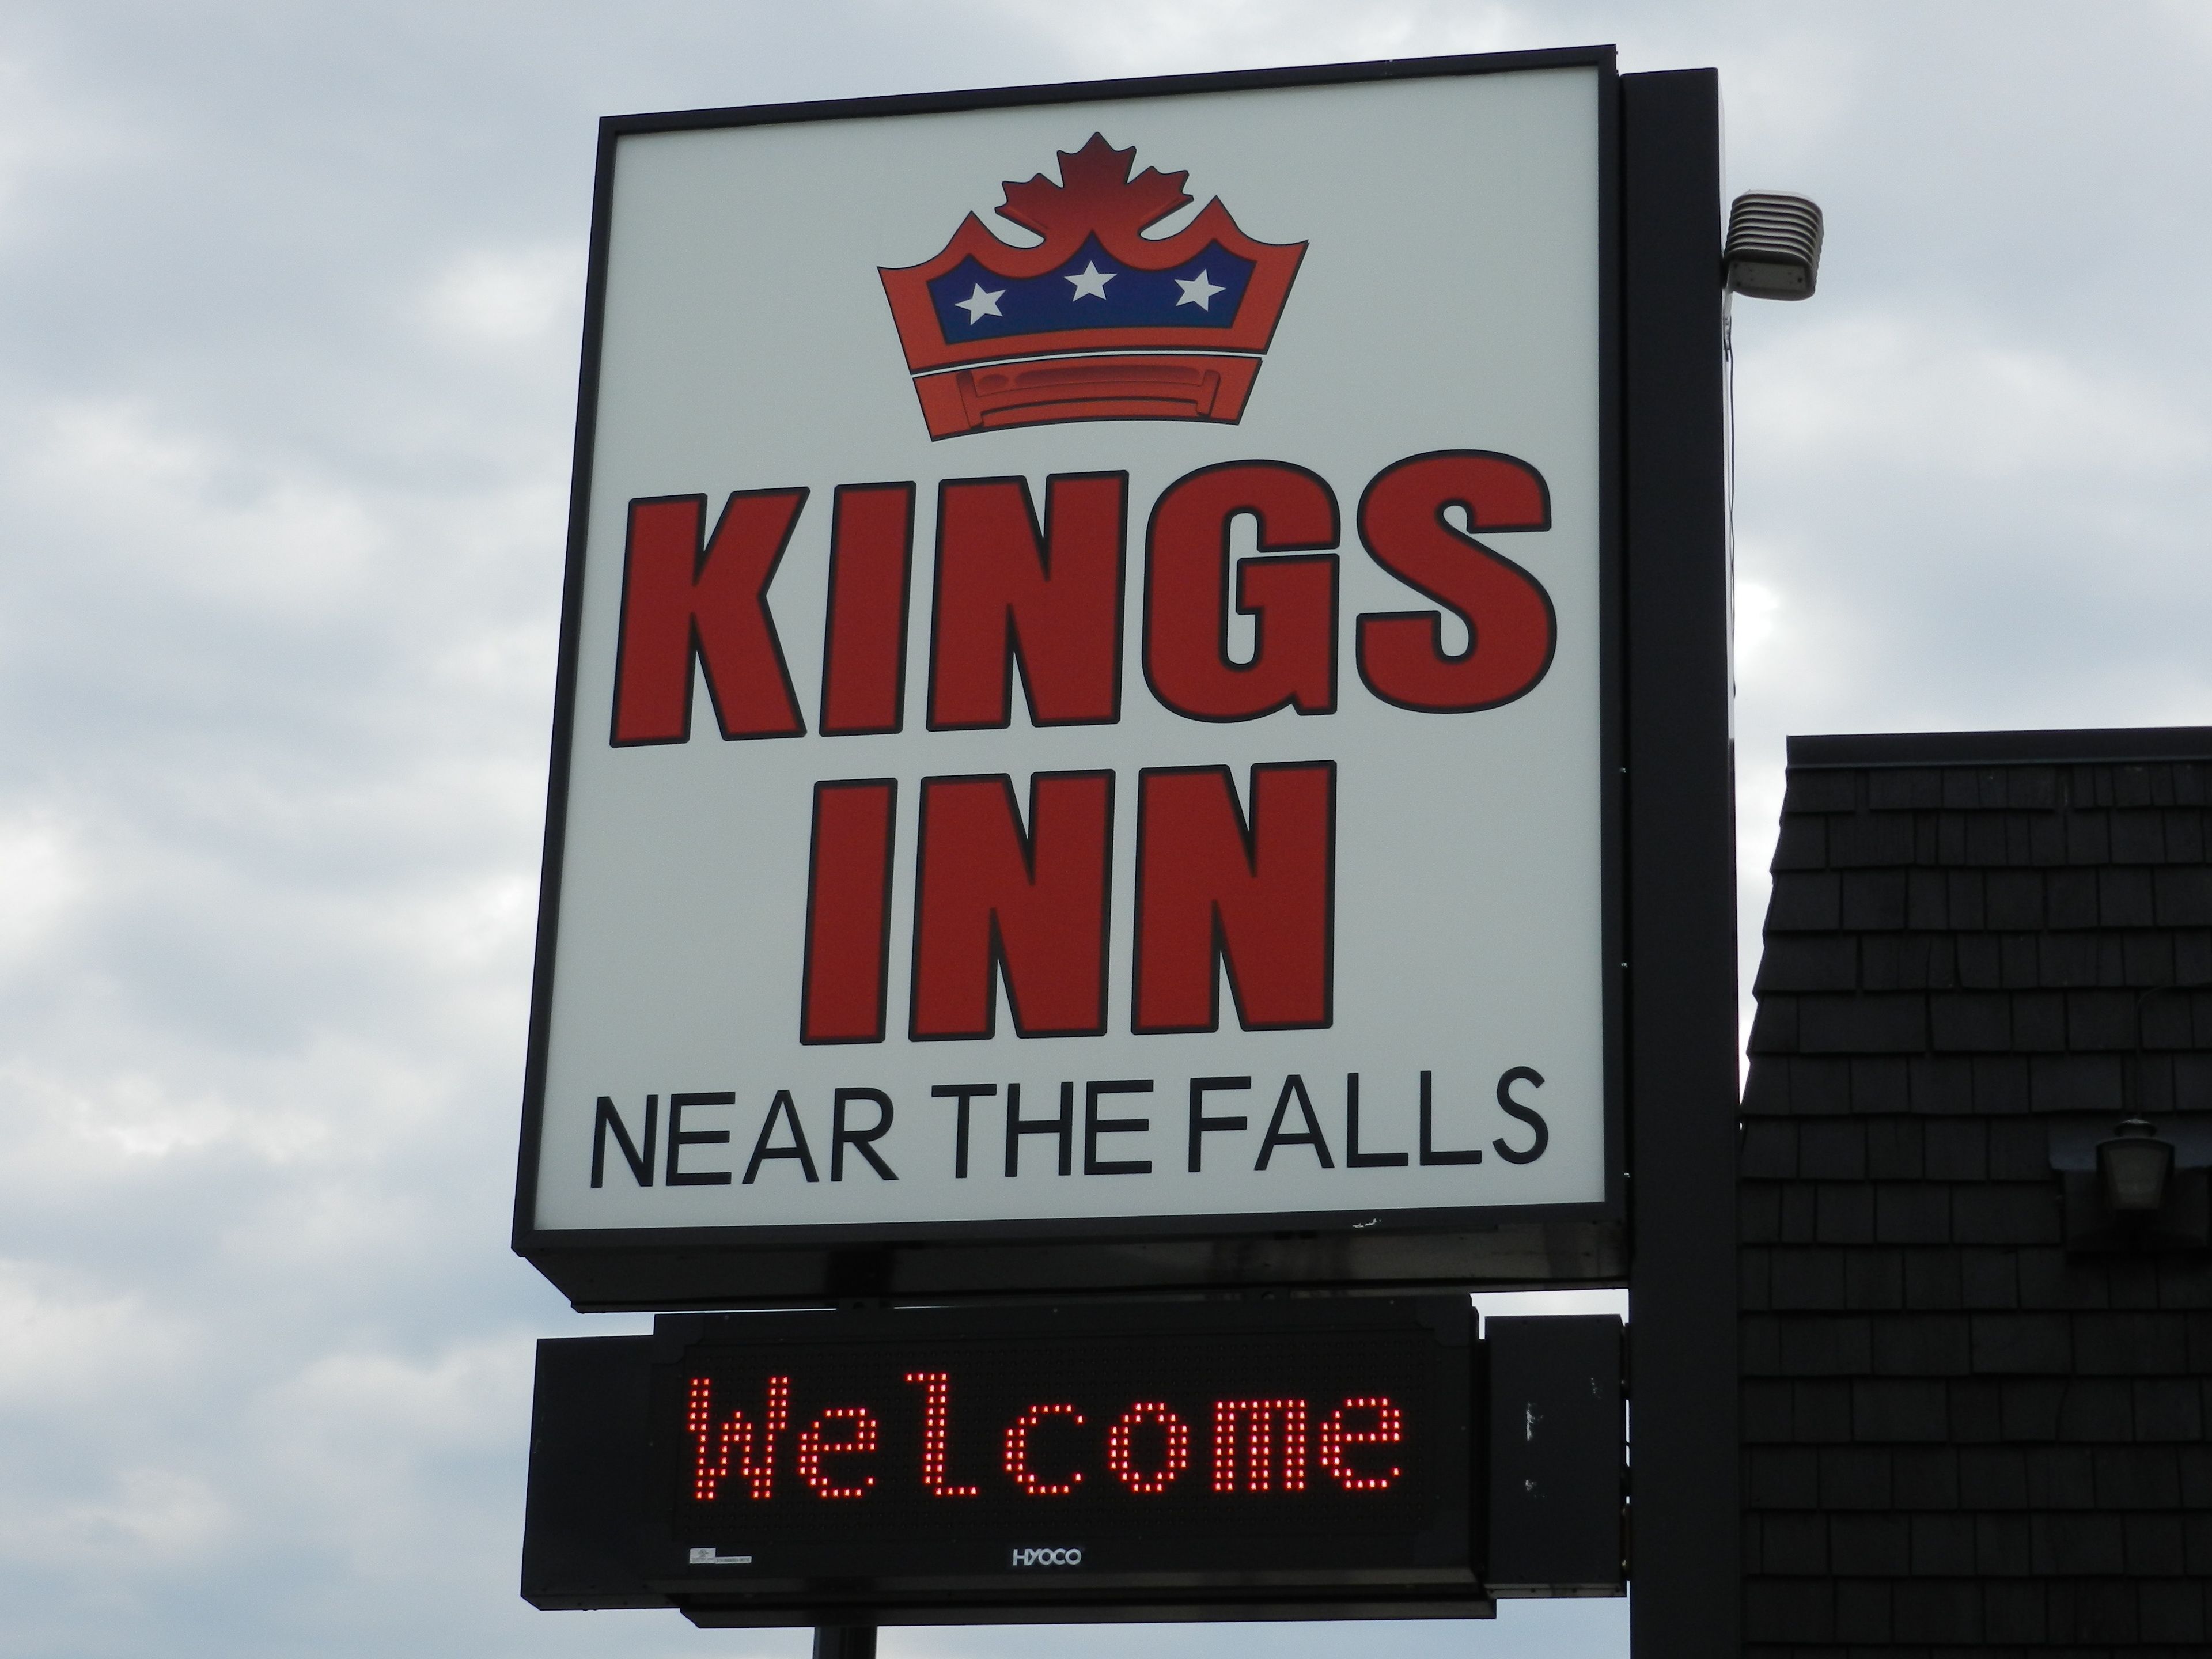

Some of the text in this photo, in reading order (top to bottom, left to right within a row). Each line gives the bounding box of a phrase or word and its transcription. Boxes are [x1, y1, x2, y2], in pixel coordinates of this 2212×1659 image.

[609, 449, 1557, 748] KINGS
[800, 760, 1337, 1046] INN
[590, 1066, 1549, 1189] NEAR THE FALLS
[685, 1371, 1403, 1501] Welcome
[1012, 1547, 1082, 1566] HYOCO
